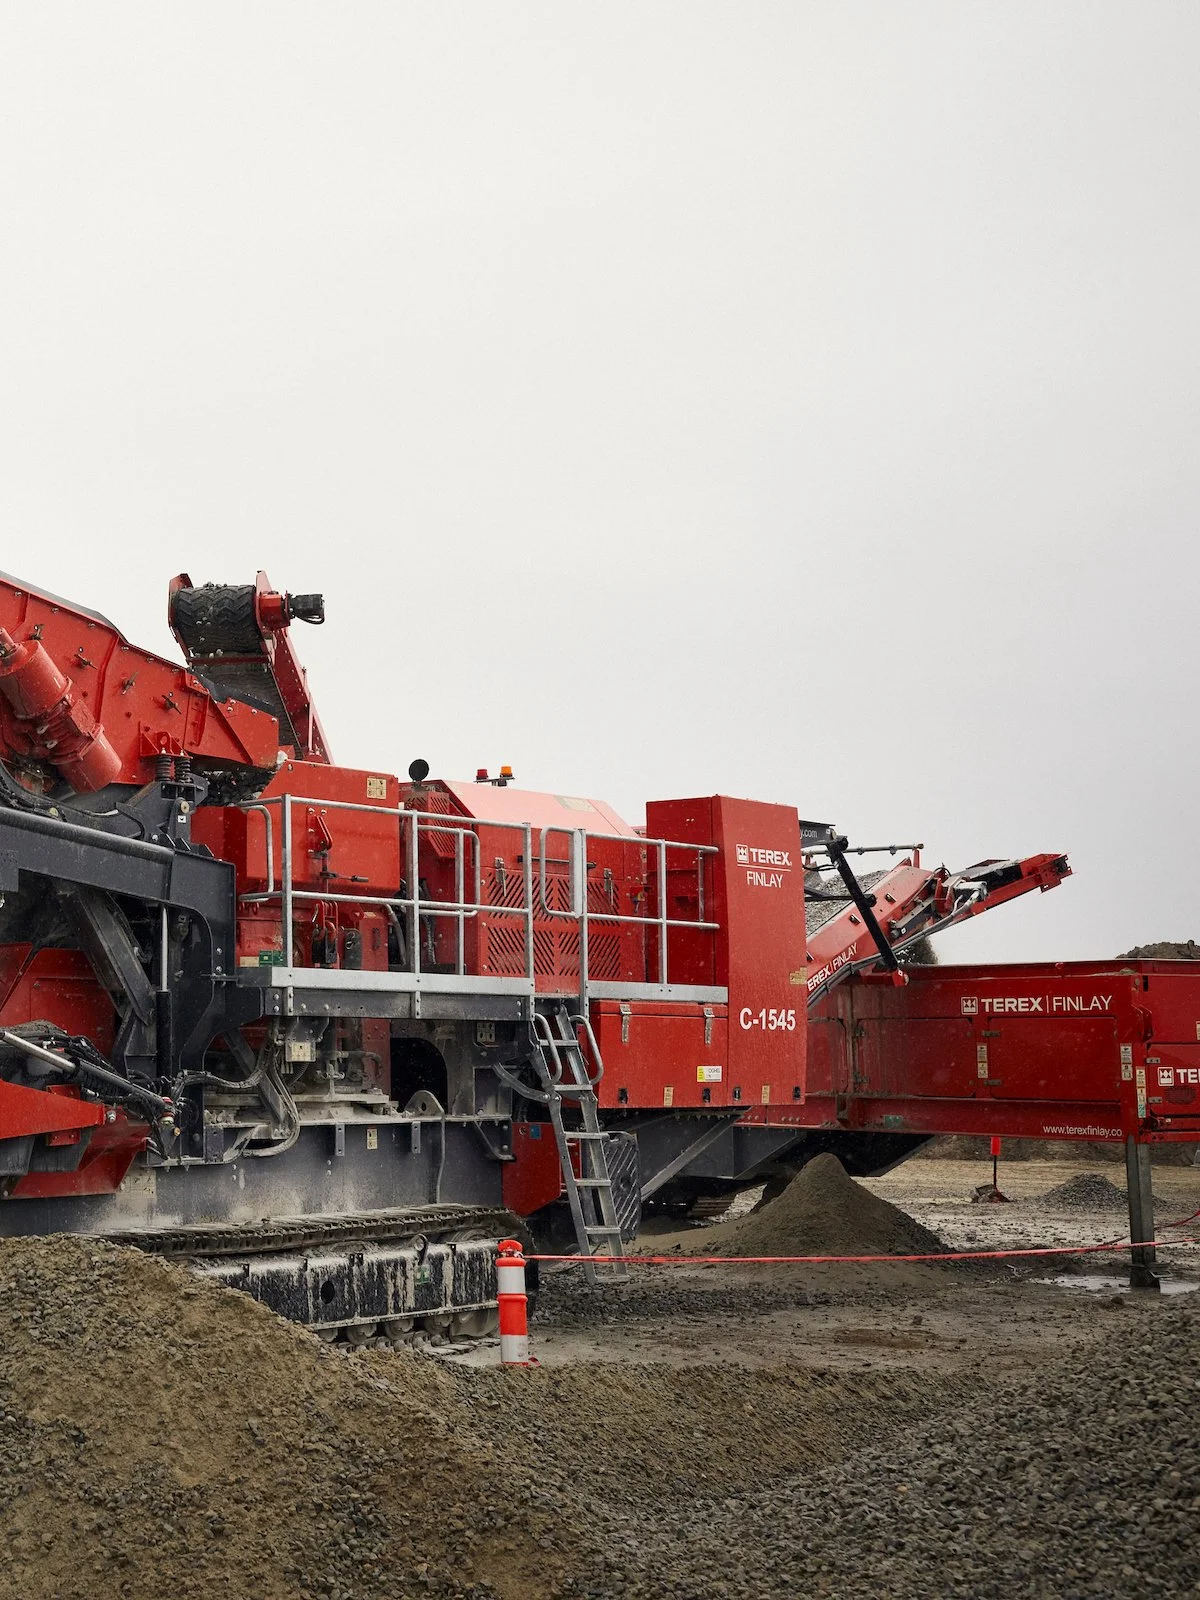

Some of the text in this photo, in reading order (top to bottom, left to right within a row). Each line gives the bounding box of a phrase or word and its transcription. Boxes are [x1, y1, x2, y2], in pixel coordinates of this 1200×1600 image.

[749, 848, 791, 867] TEREX
[746, 870, 783, 888] FINLAY
[807, 964, 832, 991] EREX
[832, 942, 858, 970] FINLAY
[981, 995, 1112, 1012] TEREX FINLAY
[740, 1007, 796, 1031] C-1545
[1176, 1068, 1200, 1084] TE
[1042, 1125, 1123, 1138] www.terexfinlay.co
